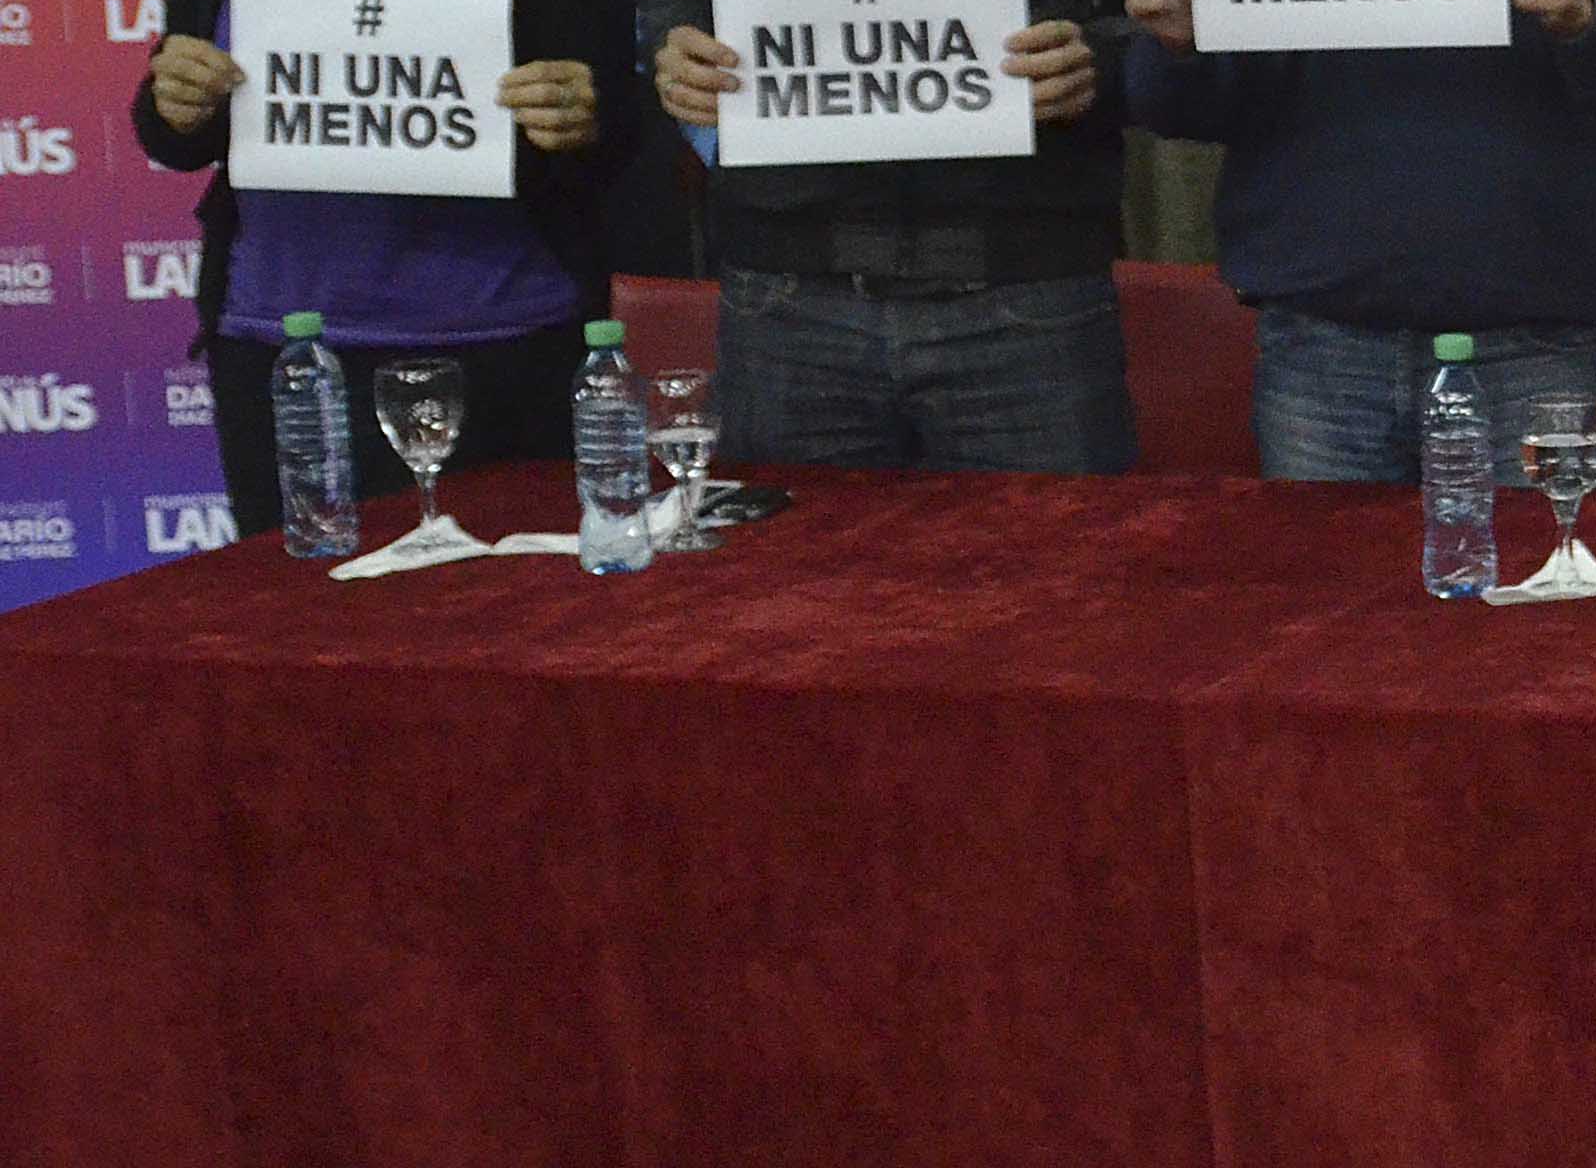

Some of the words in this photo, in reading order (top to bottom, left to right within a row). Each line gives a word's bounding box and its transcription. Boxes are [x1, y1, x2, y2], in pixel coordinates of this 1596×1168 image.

[752, 23, 817, 68] NI
[843, 18, 979, 66] UNA
[266, 52, 321, 96] NI
[343, 54, 464, 100] UNA
[754, 68, 993, 119] MENOS
[265, 101, 479, 150] MENOS
